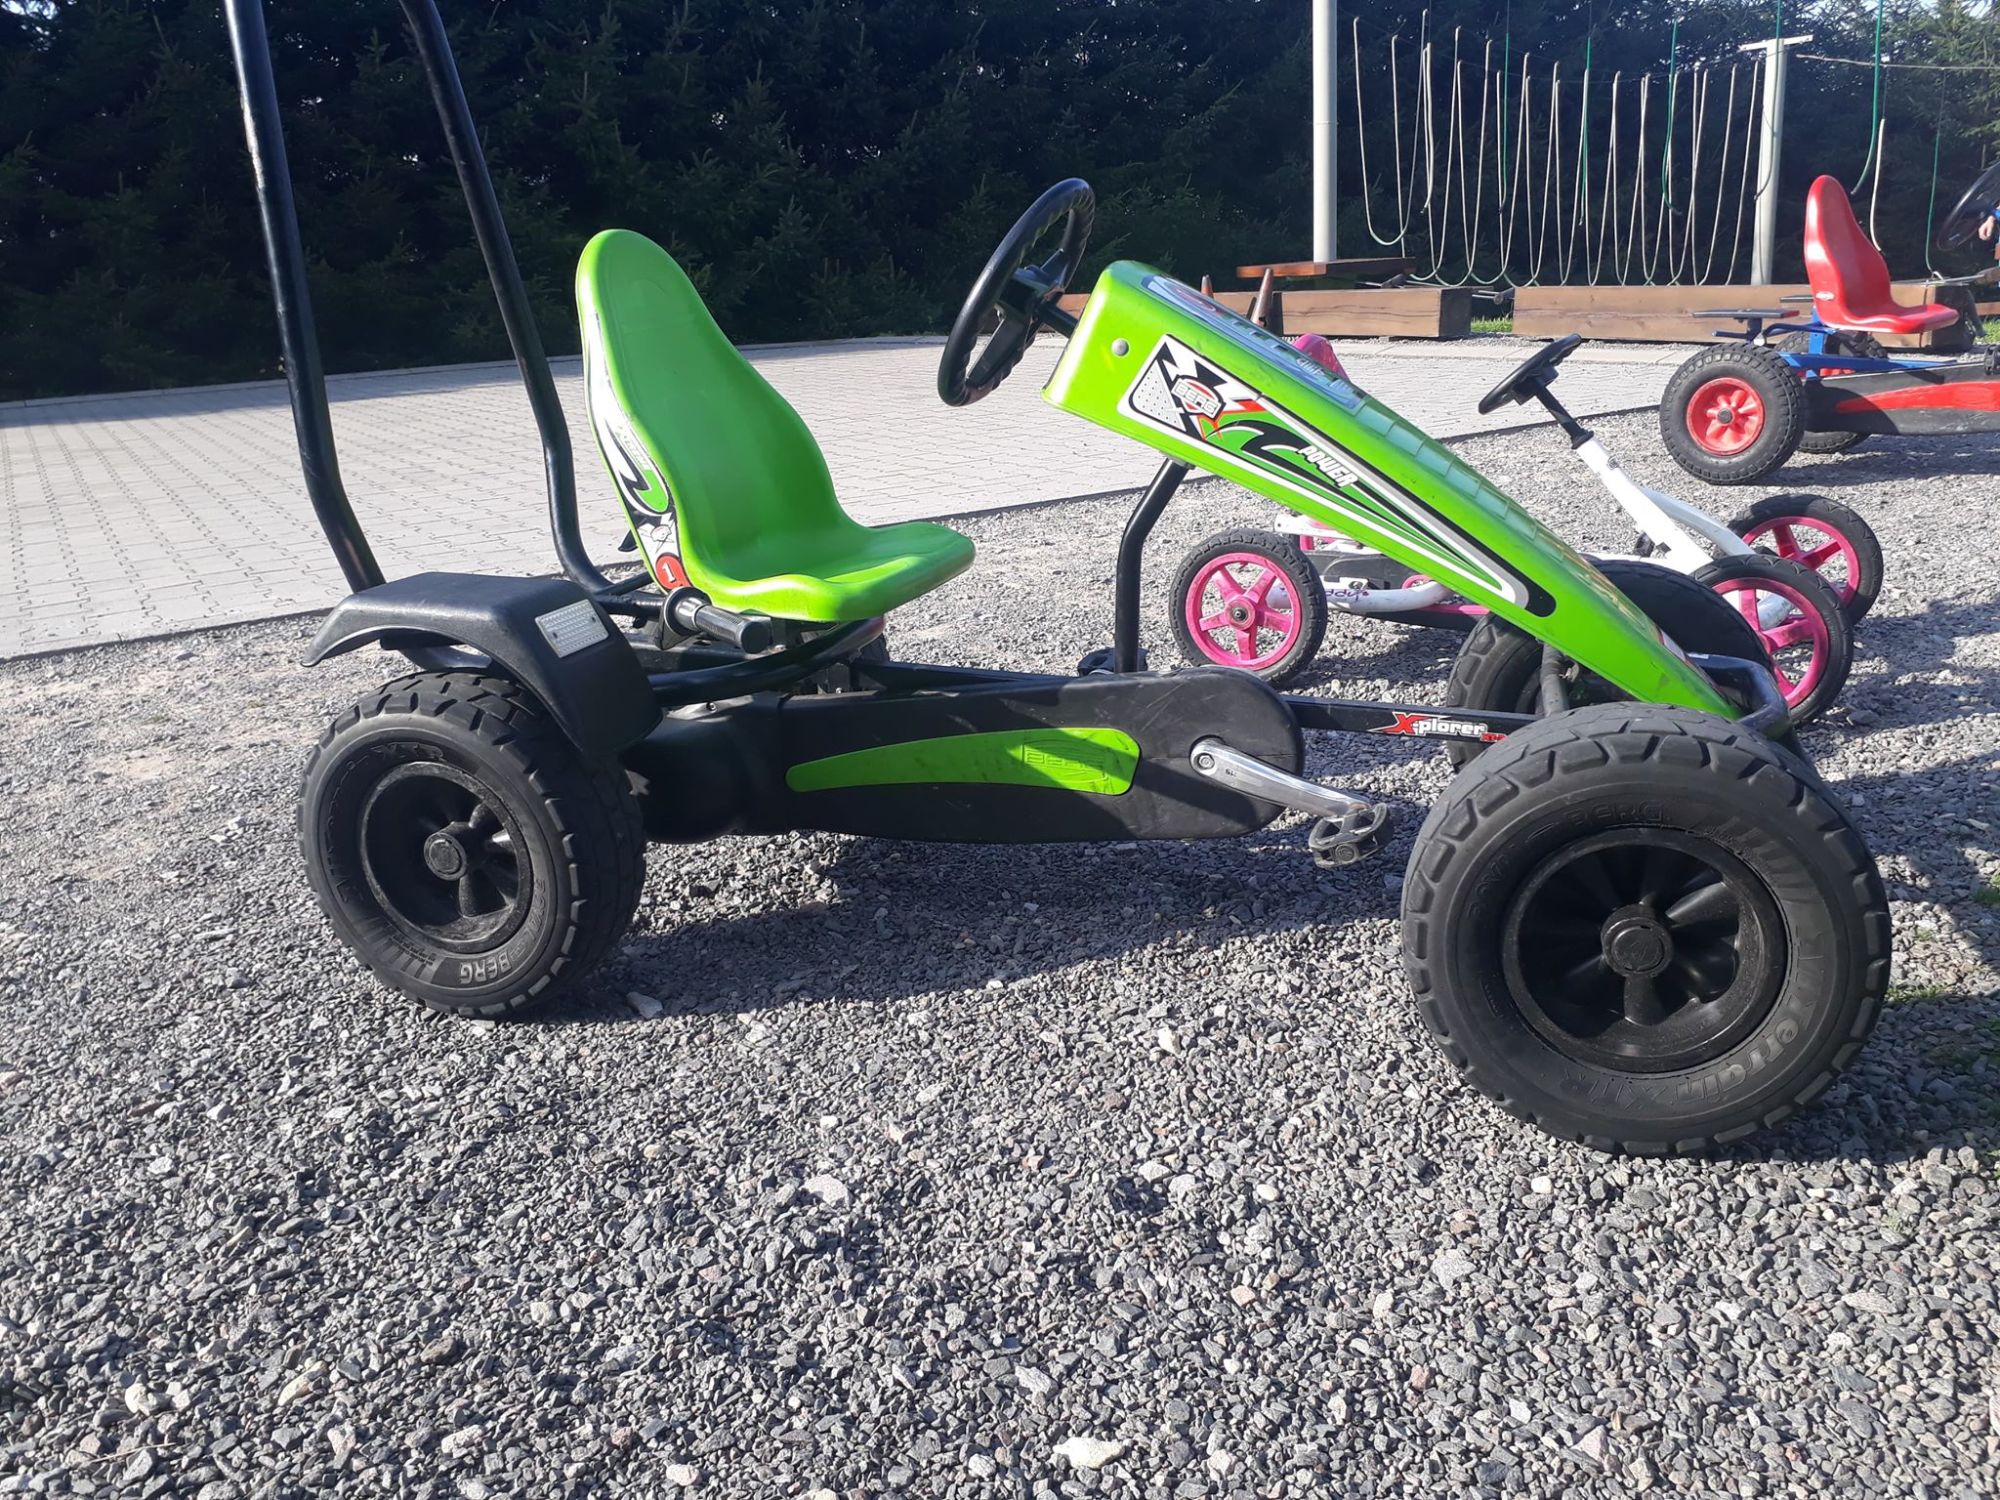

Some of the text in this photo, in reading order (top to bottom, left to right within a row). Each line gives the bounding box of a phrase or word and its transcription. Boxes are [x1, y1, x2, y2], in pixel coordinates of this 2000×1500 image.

[1174, 381, 1220, 416] BERG
[1297, 444, 1359, 488] POWER
[662, 562, 676, 584] 1
[1325, 588, 1363, 602] ddy
[460, 951, 513, 984] BERG
[1674, 994, 1817, 1106] Terrain
